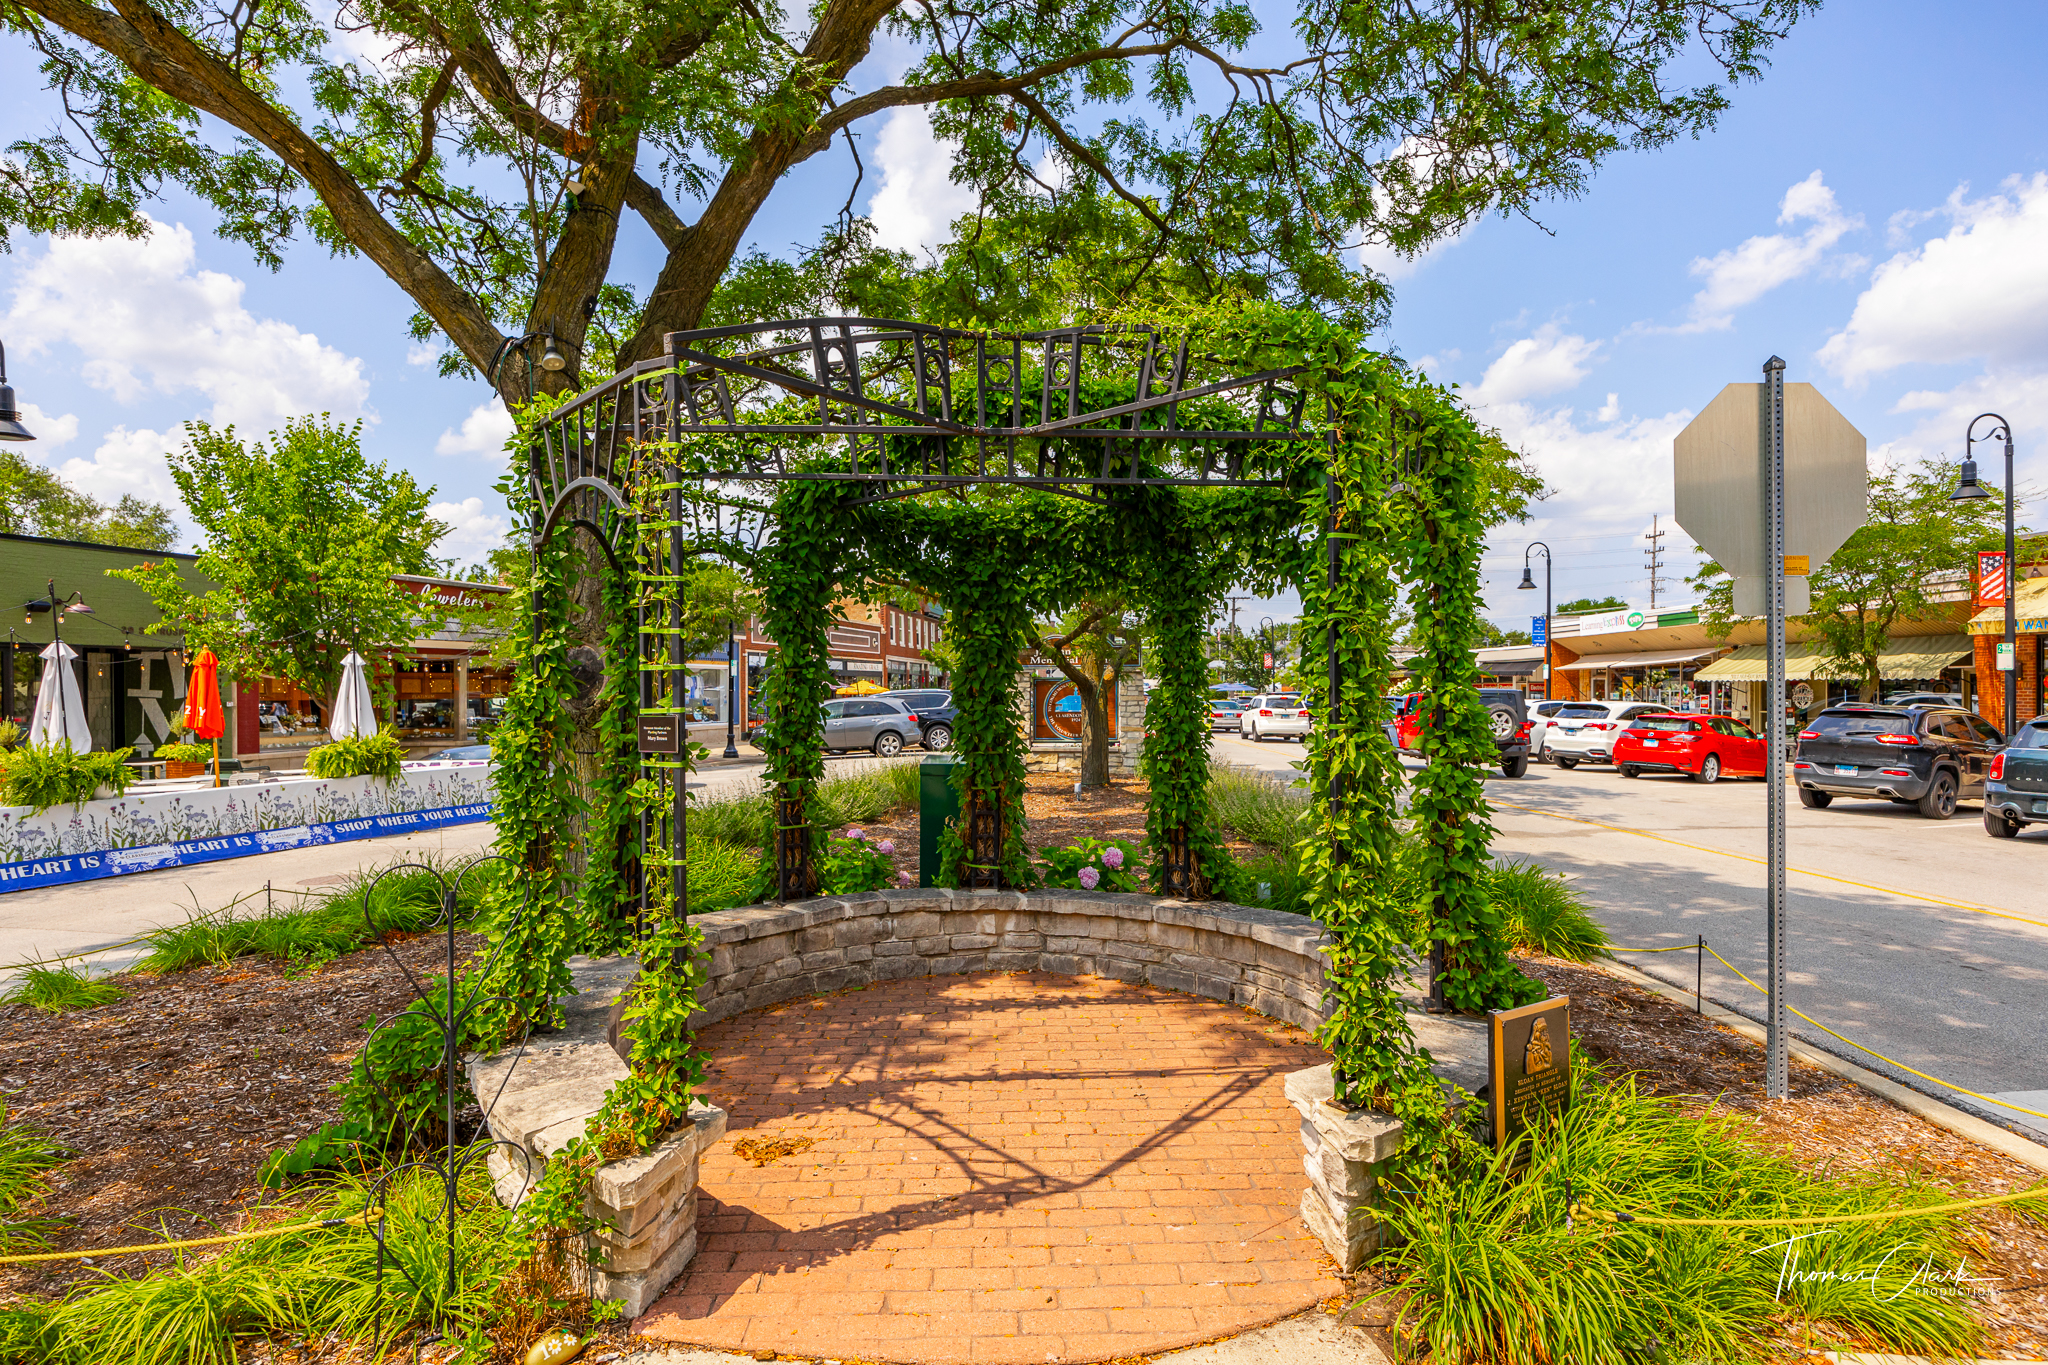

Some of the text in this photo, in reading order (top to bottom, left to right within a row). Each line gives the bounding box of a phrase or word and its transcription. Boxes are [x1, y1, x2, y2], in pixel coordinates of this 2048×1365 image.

[334, 804, 491, 834] SHOP WHERE YOUR HEART
[175, 835, 252, 855] HEART IS
[0, 855, 101, 881] HEART IS
